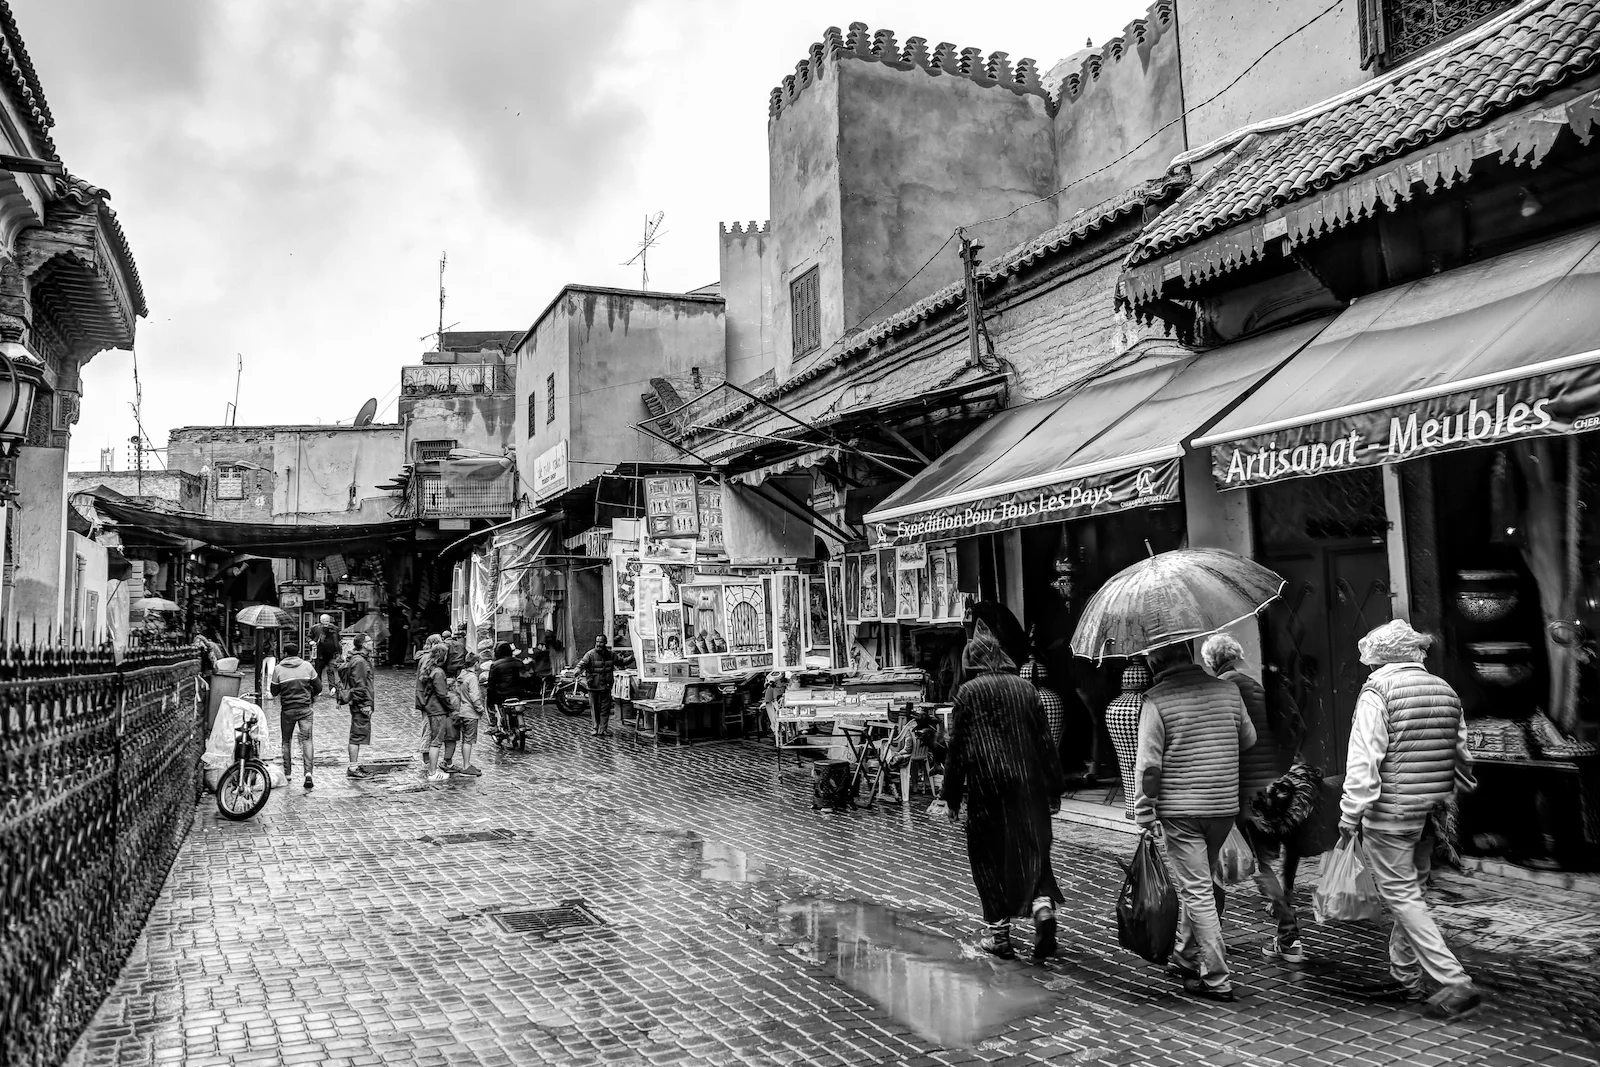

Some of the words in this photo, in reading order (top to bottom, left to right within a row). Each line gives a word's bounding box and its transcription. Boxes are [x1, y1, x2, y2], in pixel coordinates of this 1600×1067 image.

[1225, 430, 1360, 484] Artisanat
[1388, 393, 1552, 456] Meubles
[897, 513, 962, 540] Expédition
[963, 508, 997, 526] Pour
[1000, 501, 1036, 520] Tous
[1039, 493, 1066, 513] Les
[1069, 485, 1114, 509] Pays
